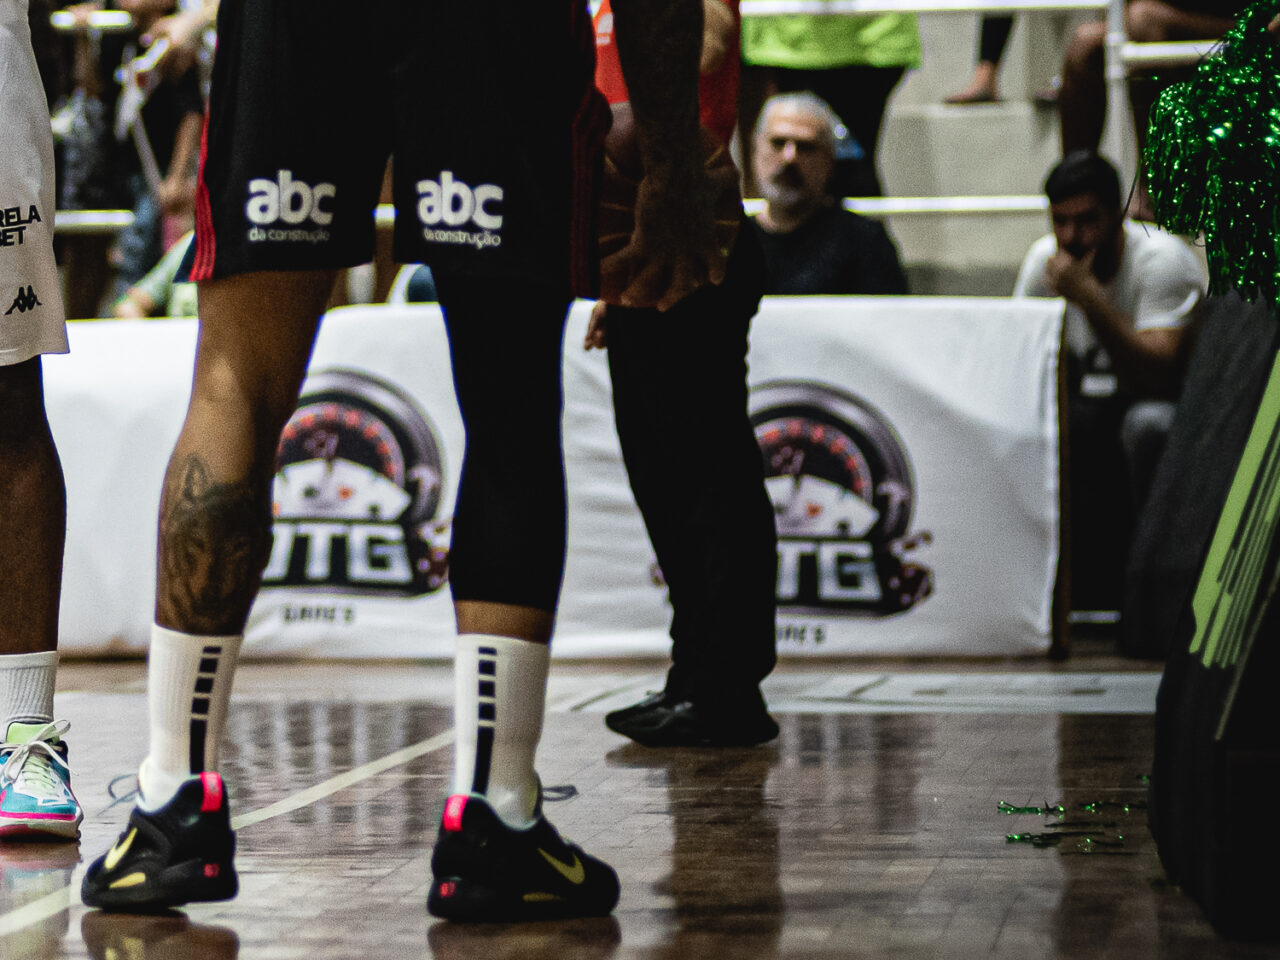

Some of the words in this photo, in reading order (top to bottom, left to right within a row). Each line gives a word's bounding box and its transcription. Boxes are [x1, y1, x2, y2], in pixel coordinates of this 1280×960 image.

[246, 169, 337, 225] abc
[416, 170, 504, 230] abc
[435, 229, 502, 250] construção
